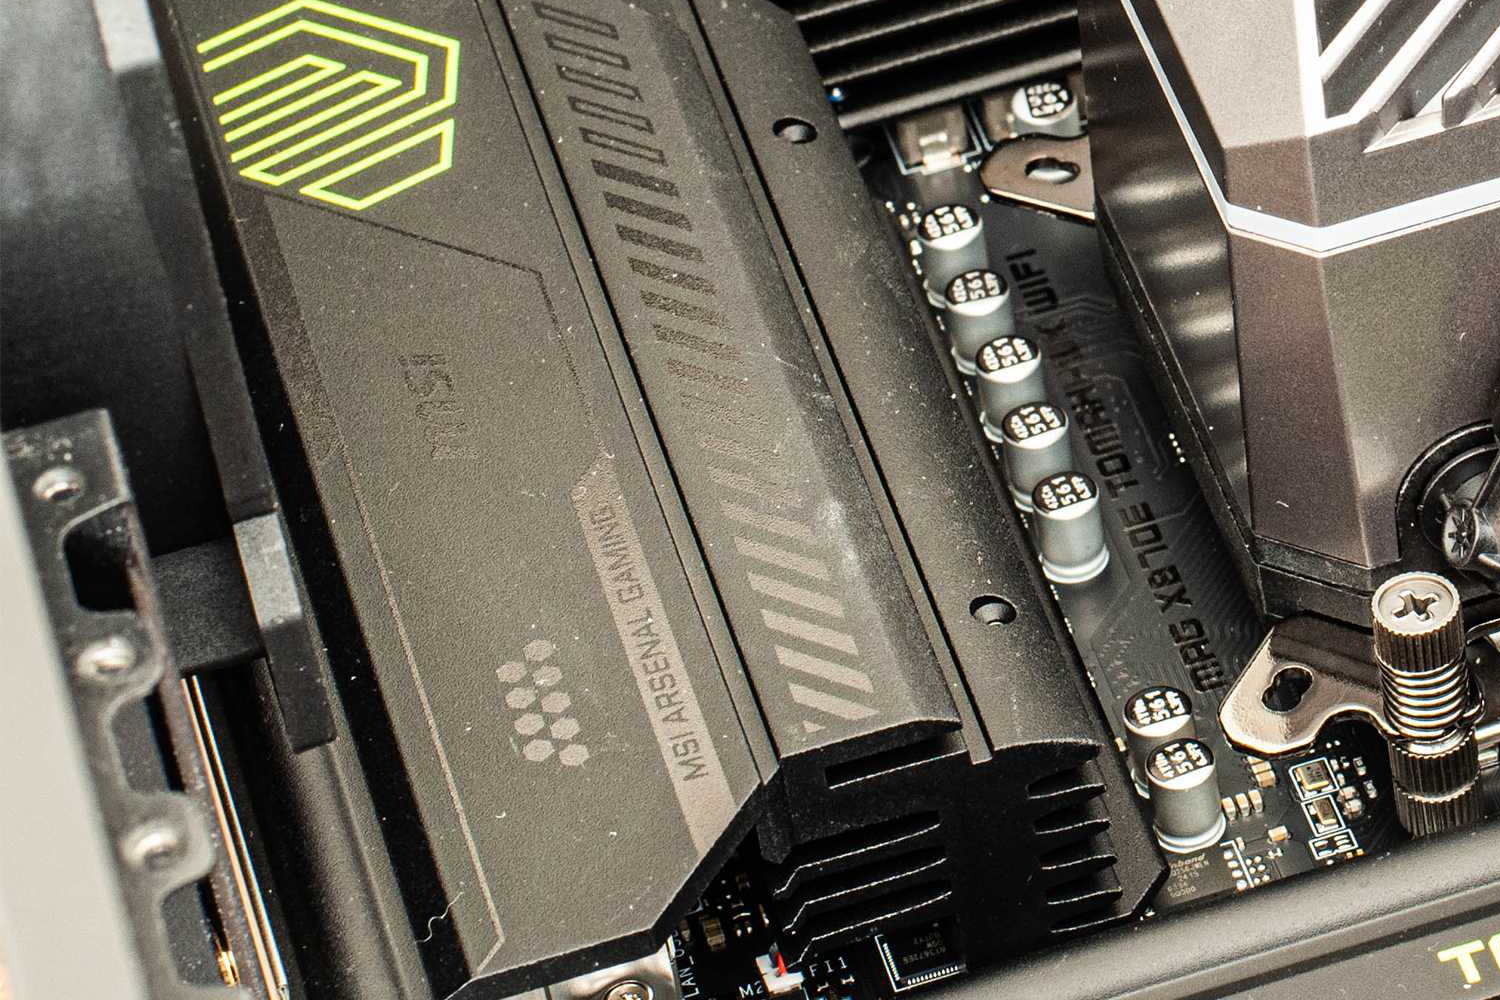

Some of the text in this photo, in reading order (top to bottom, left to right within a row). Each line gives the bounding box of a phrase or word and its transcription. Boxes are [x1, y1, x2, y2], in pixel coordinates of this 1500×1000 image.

[934, 206, 960, 235] 561
[965, 271, 985, 300] 561
[1006, 249, 1059, 316] WIFI
[993, 338, 1018, 367] 561
[1020, 406, 1047, 434] 561
[1051, 476, 1077, 505] 561
[1119, 502, 1193, 614] X870E
[589, 505, 708, 781] MSI ARSENAL GAMING
[1144, 690, 1170, 721] 561
[1164, 743, 1194, 774] 561
